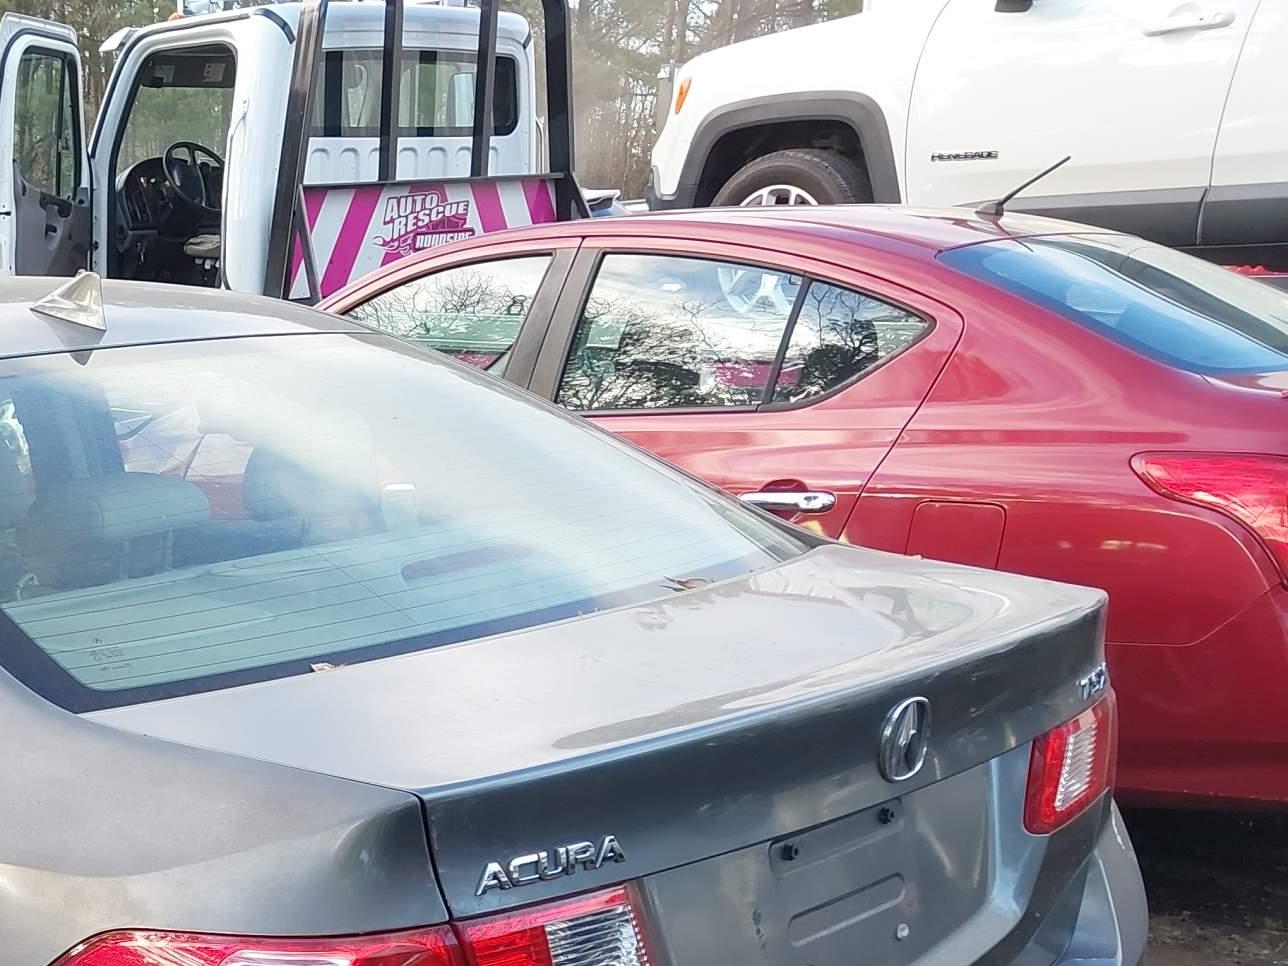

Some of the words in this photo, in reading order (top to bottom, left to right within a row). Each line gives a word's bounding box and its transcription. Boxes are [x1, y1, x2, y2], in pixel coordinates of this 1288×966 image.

[931, 150, 998, 162] RENEGADE
[384, 193, 438, 222] AUTO
[393, 201, 469, 240] RESCUE
[475, 835, 626, 896] ACURA
